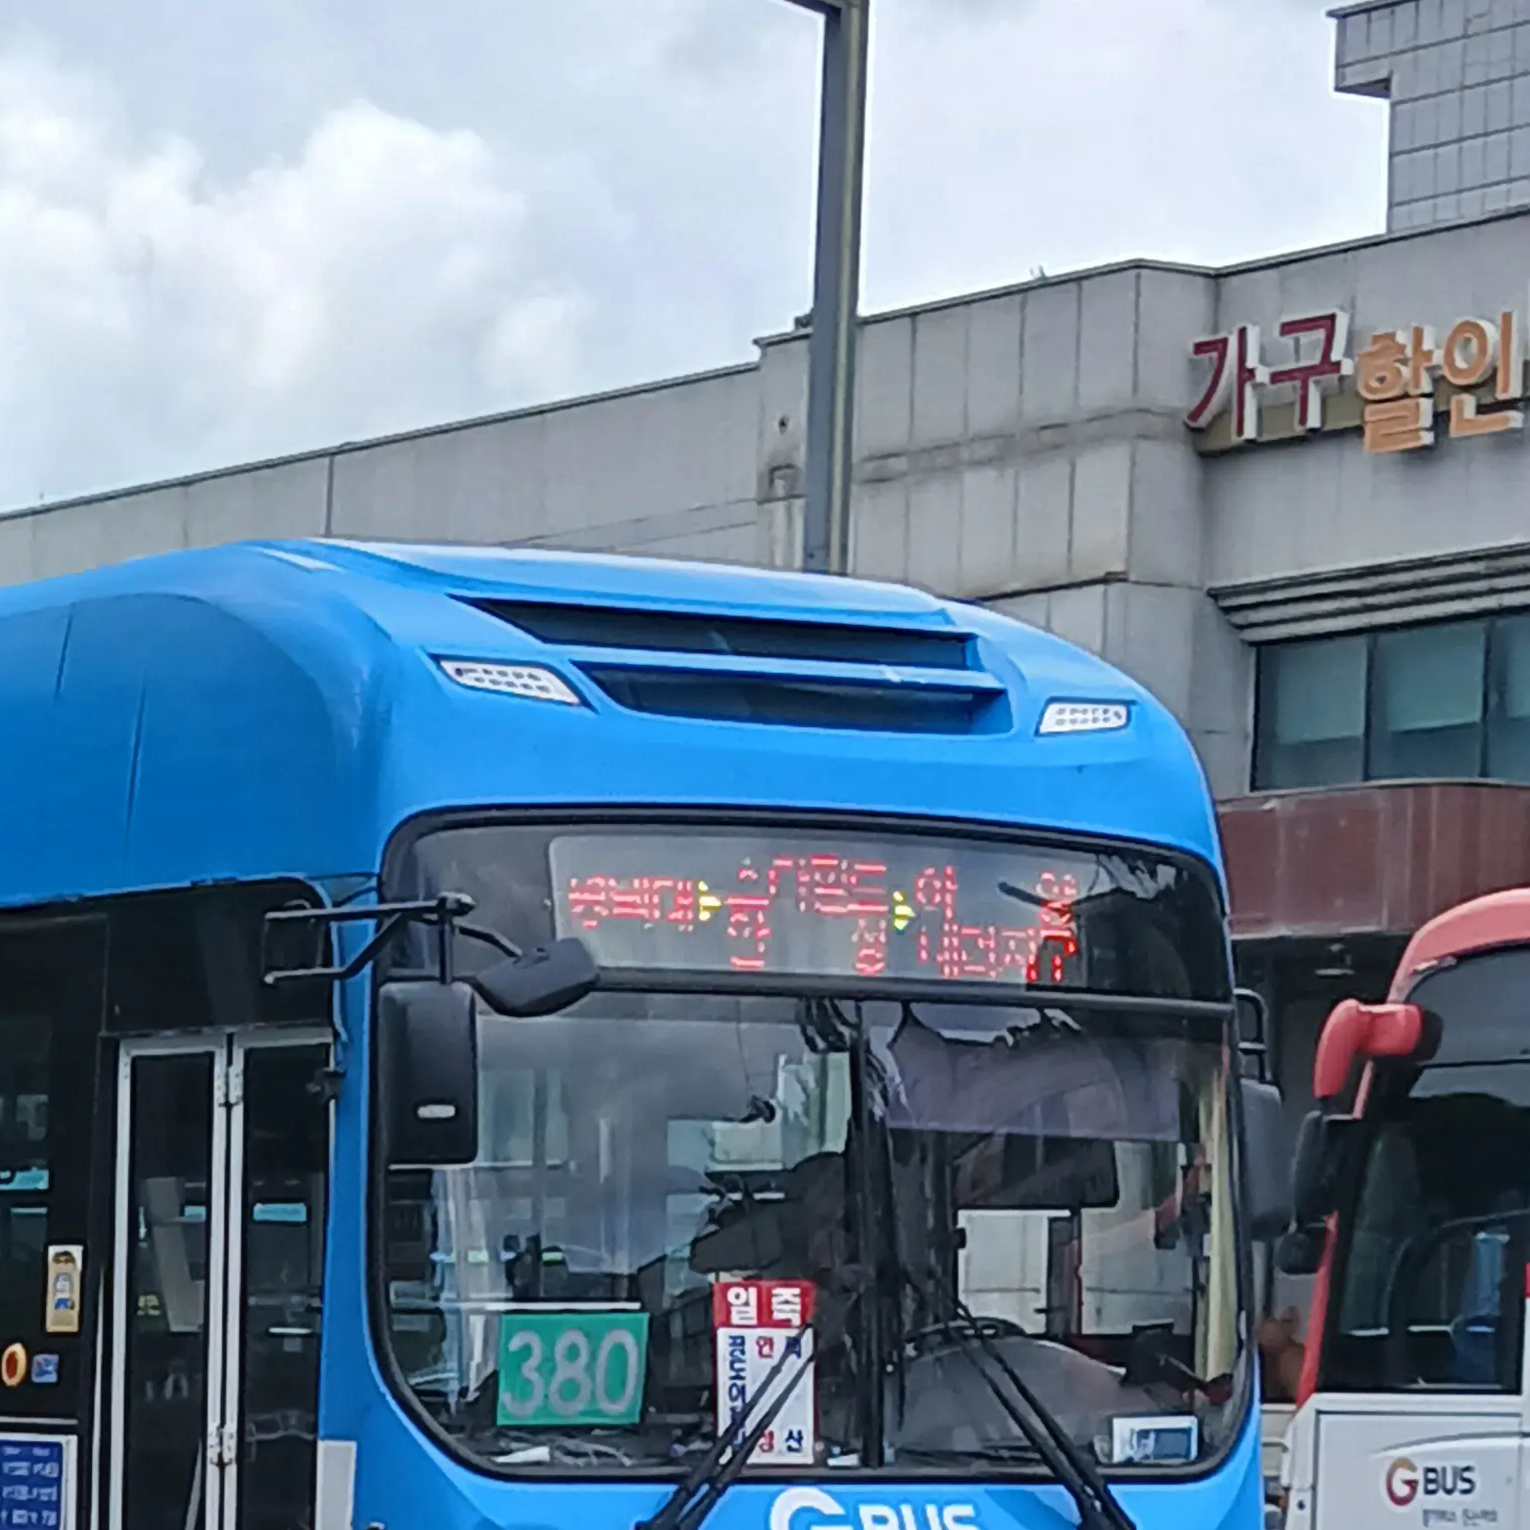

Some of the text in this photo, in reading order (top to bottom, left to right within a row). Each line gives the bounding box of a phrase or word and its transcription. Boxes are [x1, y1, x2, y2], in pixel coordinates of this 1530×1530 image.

[1185, 310, 1522, 454] 가구 할인
[502, 1328, 640, 1418] 380
